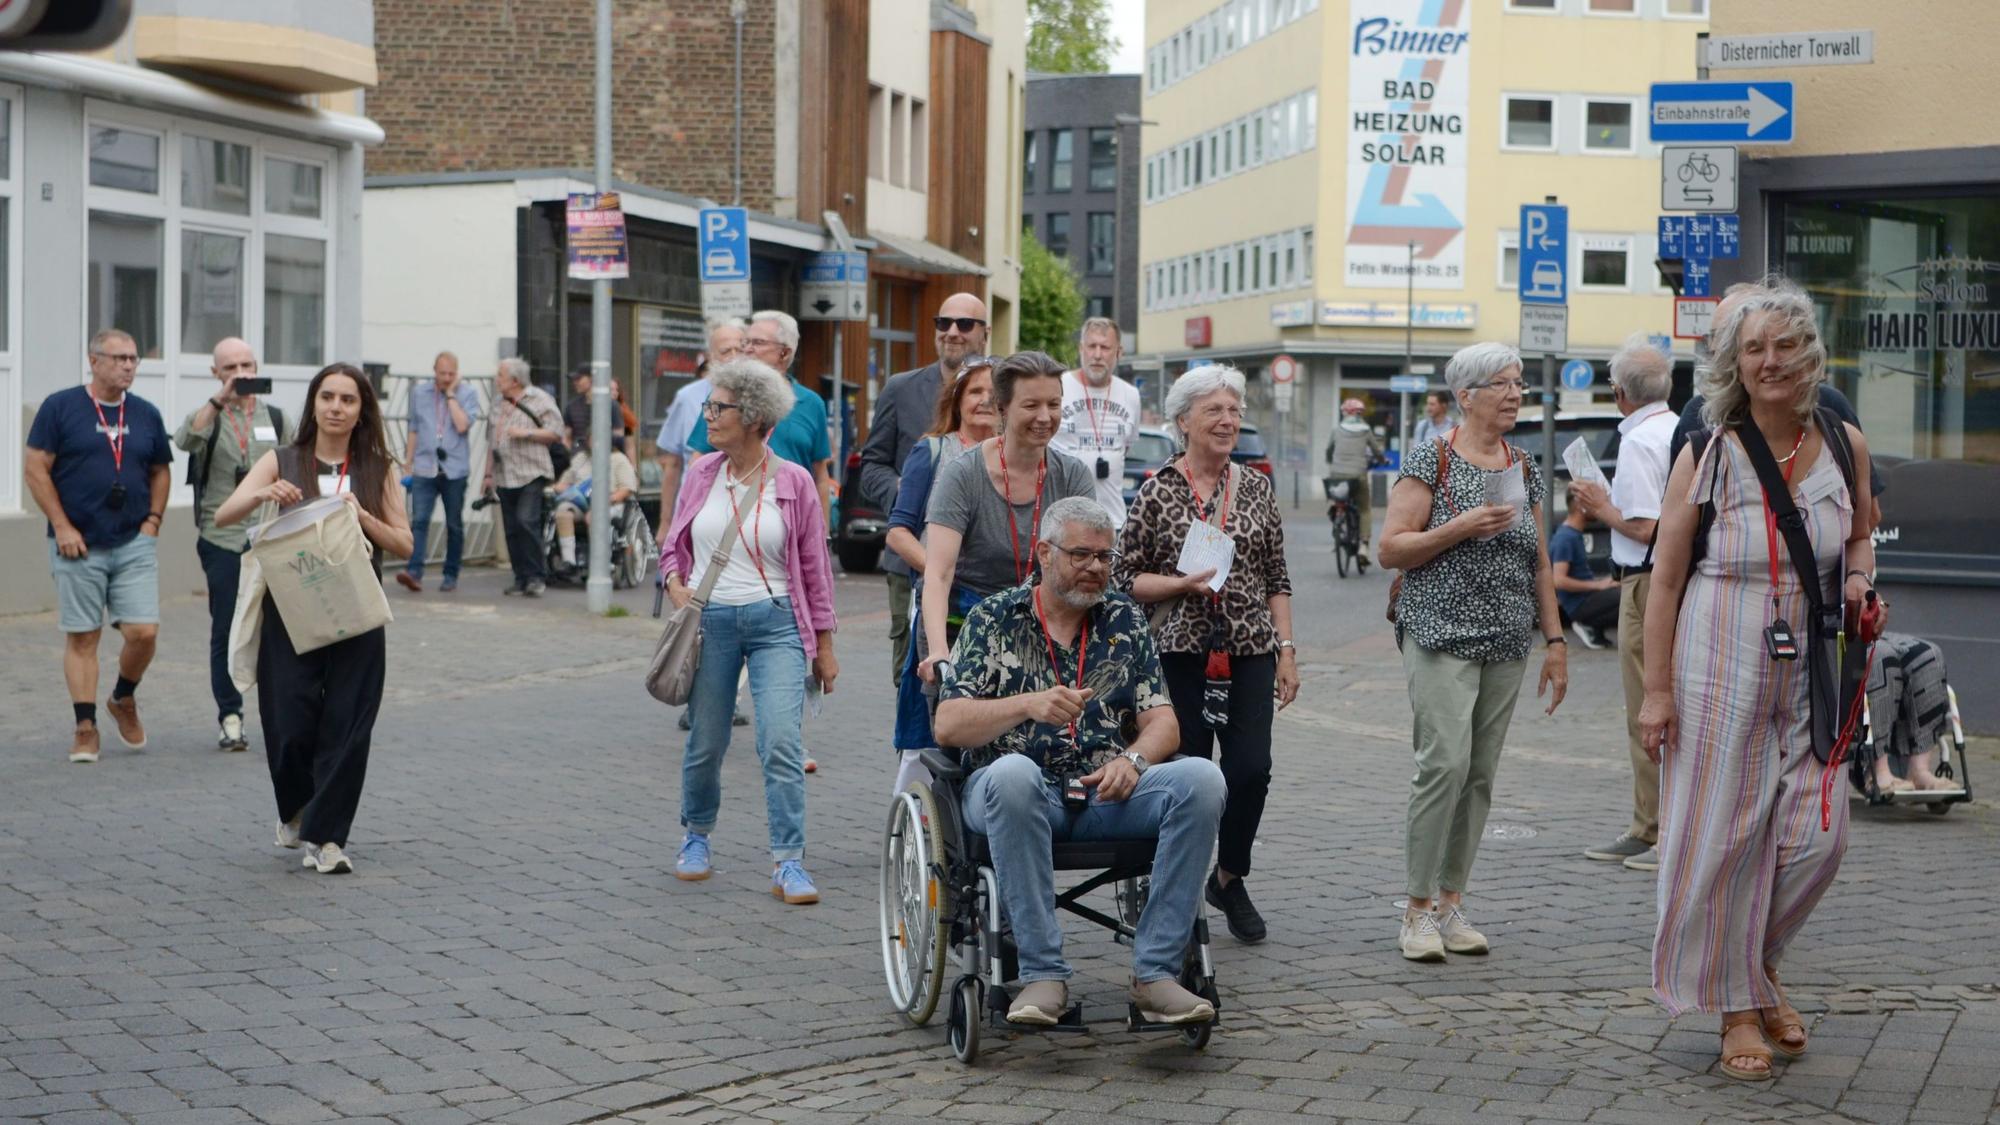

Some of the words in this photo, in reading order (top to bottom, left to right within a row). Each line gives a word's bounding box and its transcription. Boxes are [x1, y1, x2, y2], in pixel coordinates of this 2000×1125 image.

[1353, 17, 1469, 56] Binner
[1720, 40, 1803, 62] Disternicher
[1808, 36, 1861, 58] Torwall
[1383, 80, 1435, 100] BAD
[1354, 112, 1462, 134] HEIZUNG
[1656, 105, 1751, 121] Einbahnstraße
[1361, 142, 1445, 165] SOLAR
[706, 212, 728, 242] P
[1526, 210, 1548, 250] P
[1785, 235, 1799, 253] IR
[1802, 235, 1854, 253] LUXURY
[1919, 276, 1988, 304] Salon
[1867, 312, 1928, 349] HAIR
